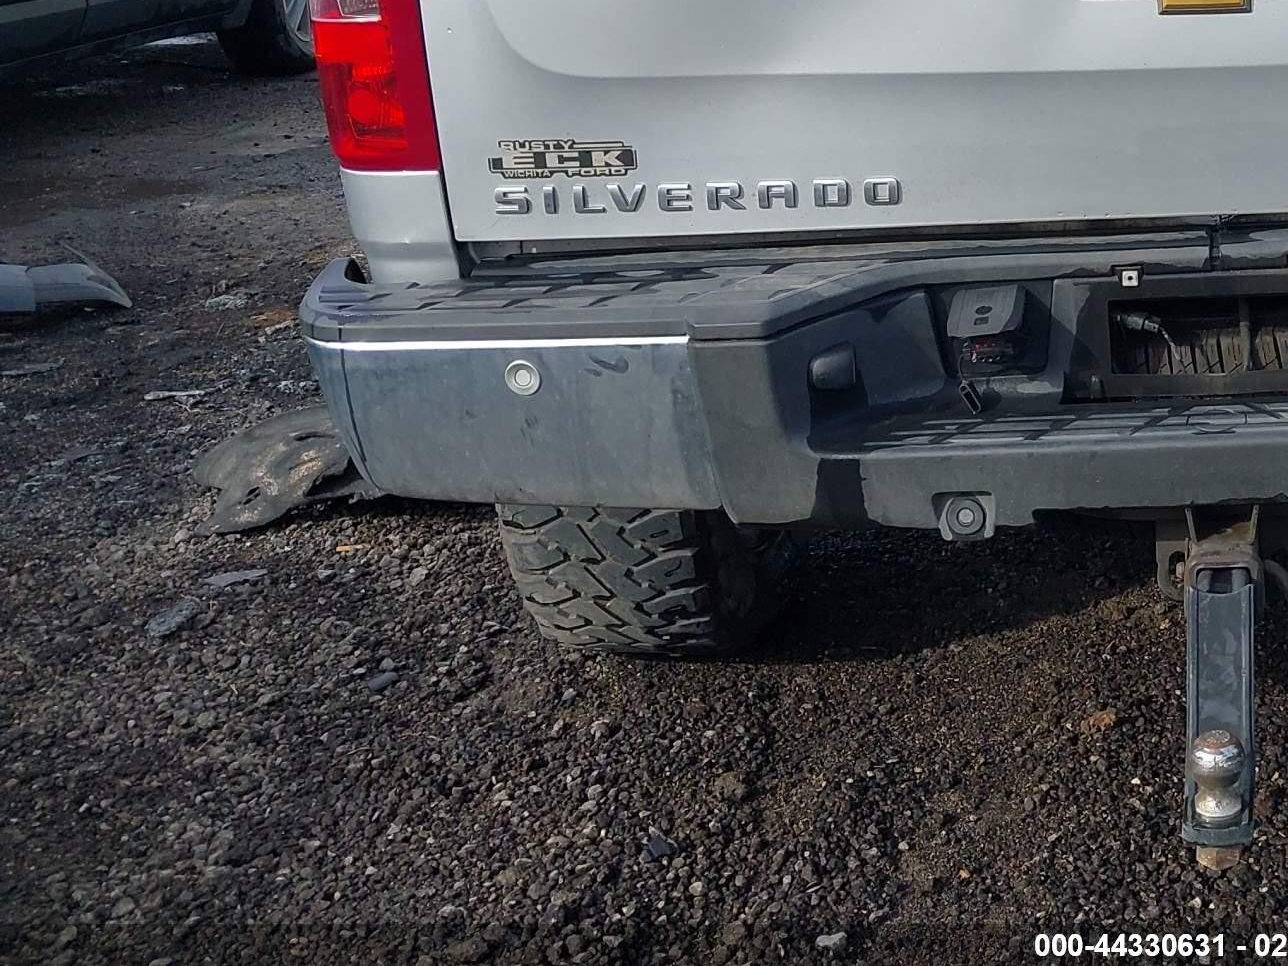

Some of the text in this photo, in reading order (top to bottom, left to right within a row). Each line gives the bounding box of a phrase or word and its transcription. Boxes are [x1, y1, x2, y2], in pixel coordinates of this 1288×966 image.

[499, 140, 574, 152] RUSTY
[501, 150, 625, 169] ECK
[503, 168, 626, 178] WICHITA FORD
[493, 176, 903, 215] SILVERADO
